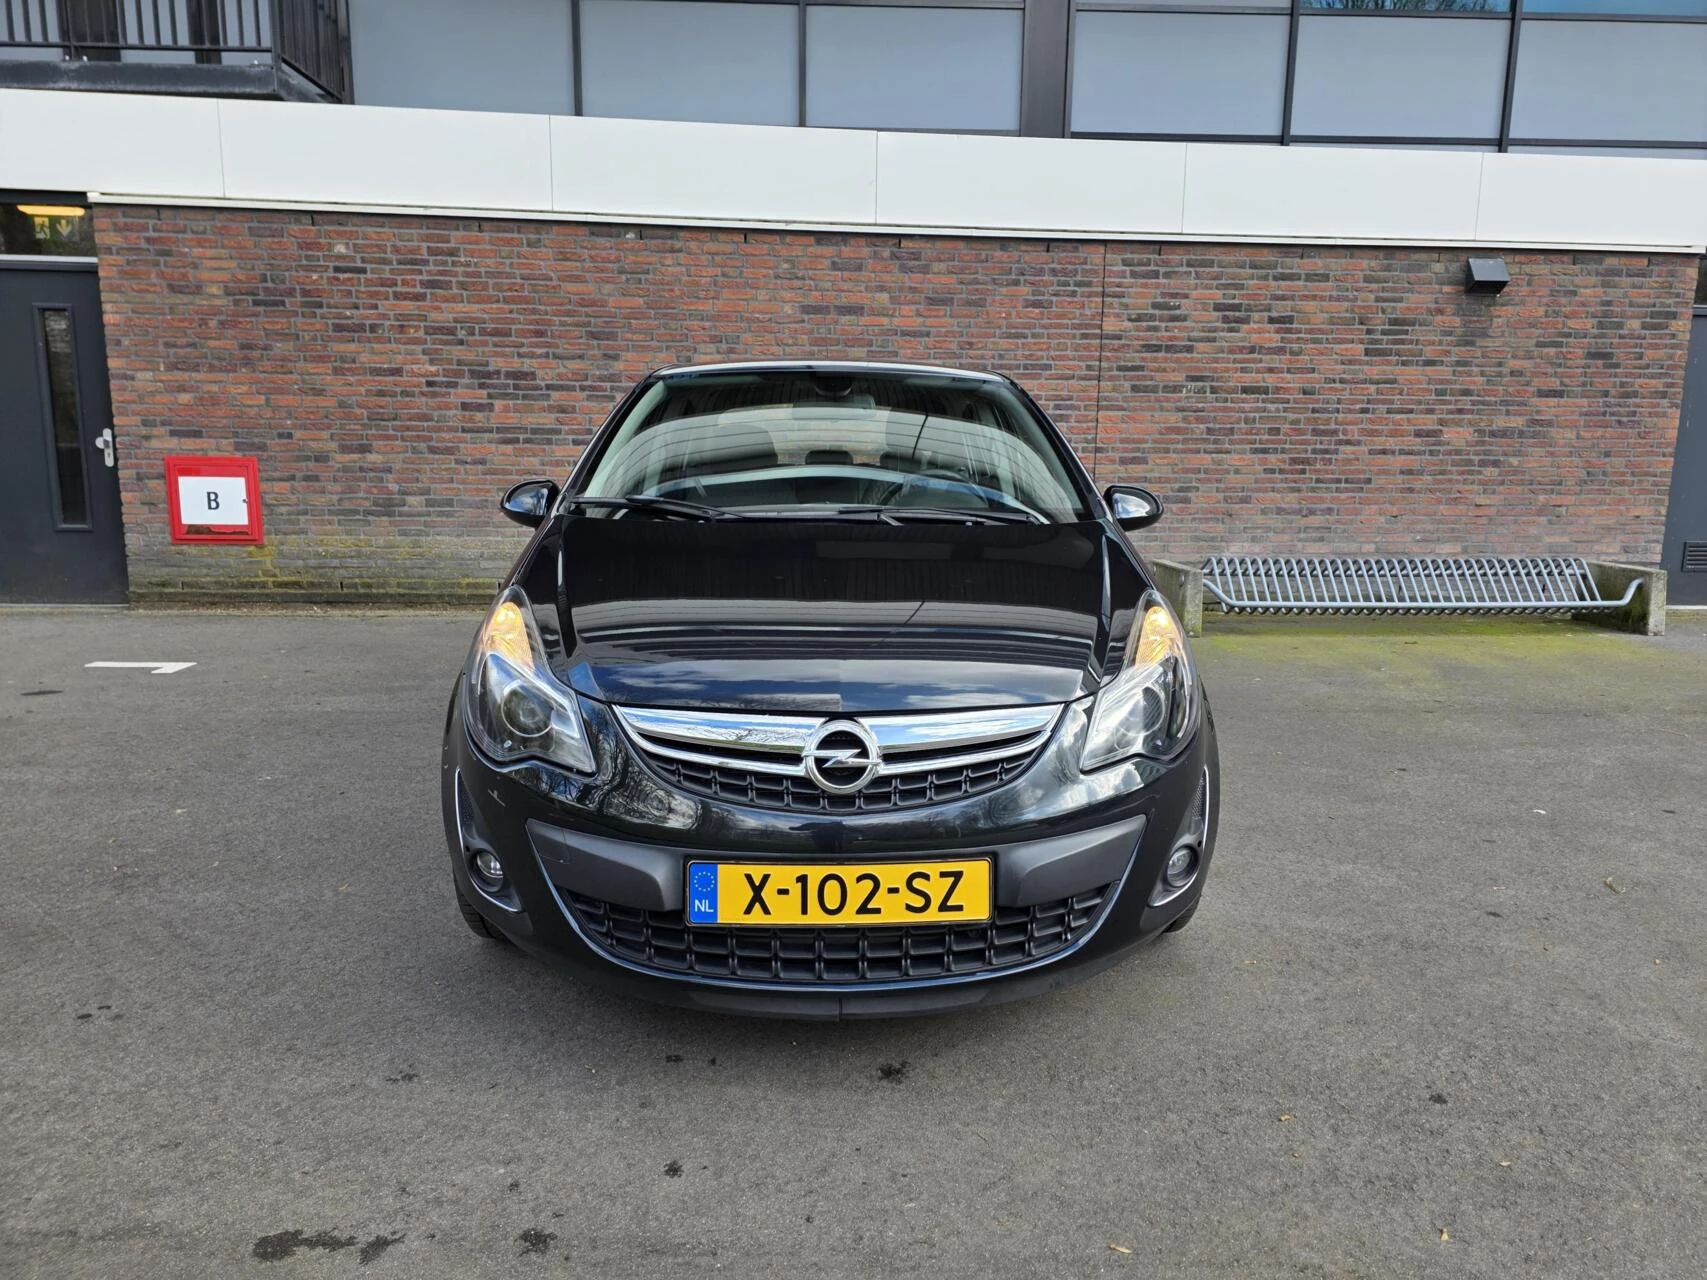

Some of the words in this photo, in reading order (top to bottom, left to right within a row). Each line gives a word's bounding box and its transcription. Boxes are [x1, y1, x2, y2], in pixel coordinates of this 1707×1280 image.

[206, 491, 220, 510] B
[743, 870, 964, 916] X-102-SZ
[694, 899, 714, 913] NL
